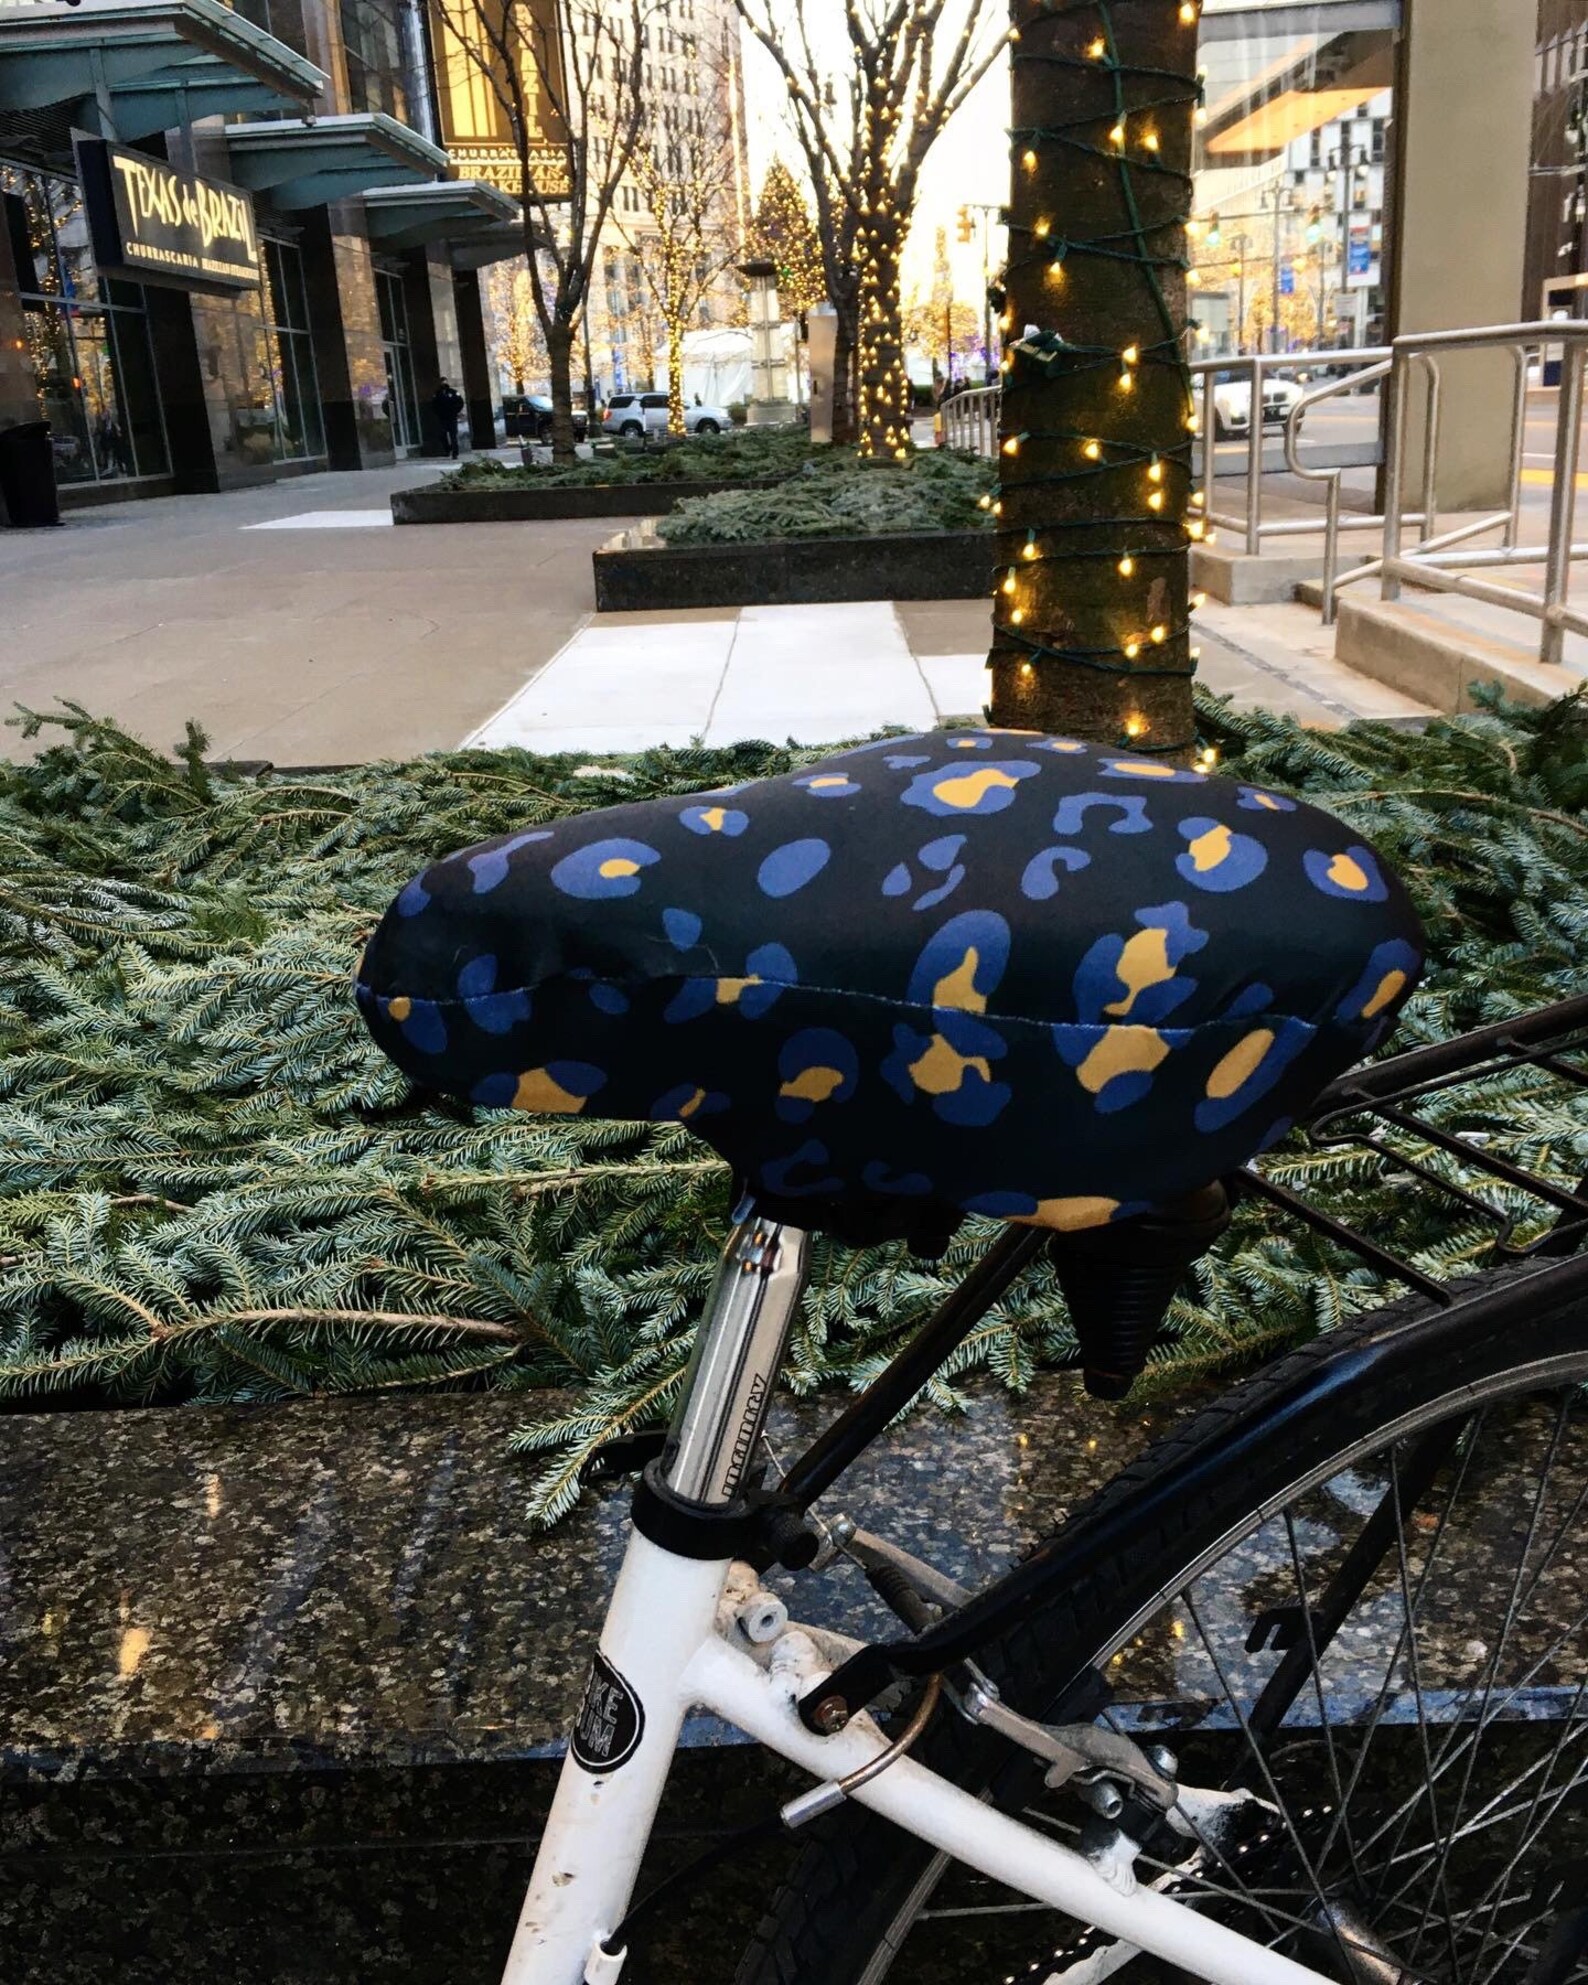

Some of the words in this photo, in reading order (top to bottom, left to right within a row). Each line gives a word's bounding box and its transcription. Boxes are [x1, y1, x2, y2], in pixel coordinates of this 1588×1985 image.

[448, 148, 567, 159] CHURRASARIA
[459, 166, 562, 180] BRAZILAN
[113, 155, 182, 236] TEXAS
[182, 183, 199, 227] de
[195, 180, 258, 262] BRAZIL
[126, 242, 199, 269] CHURRASCARIA
